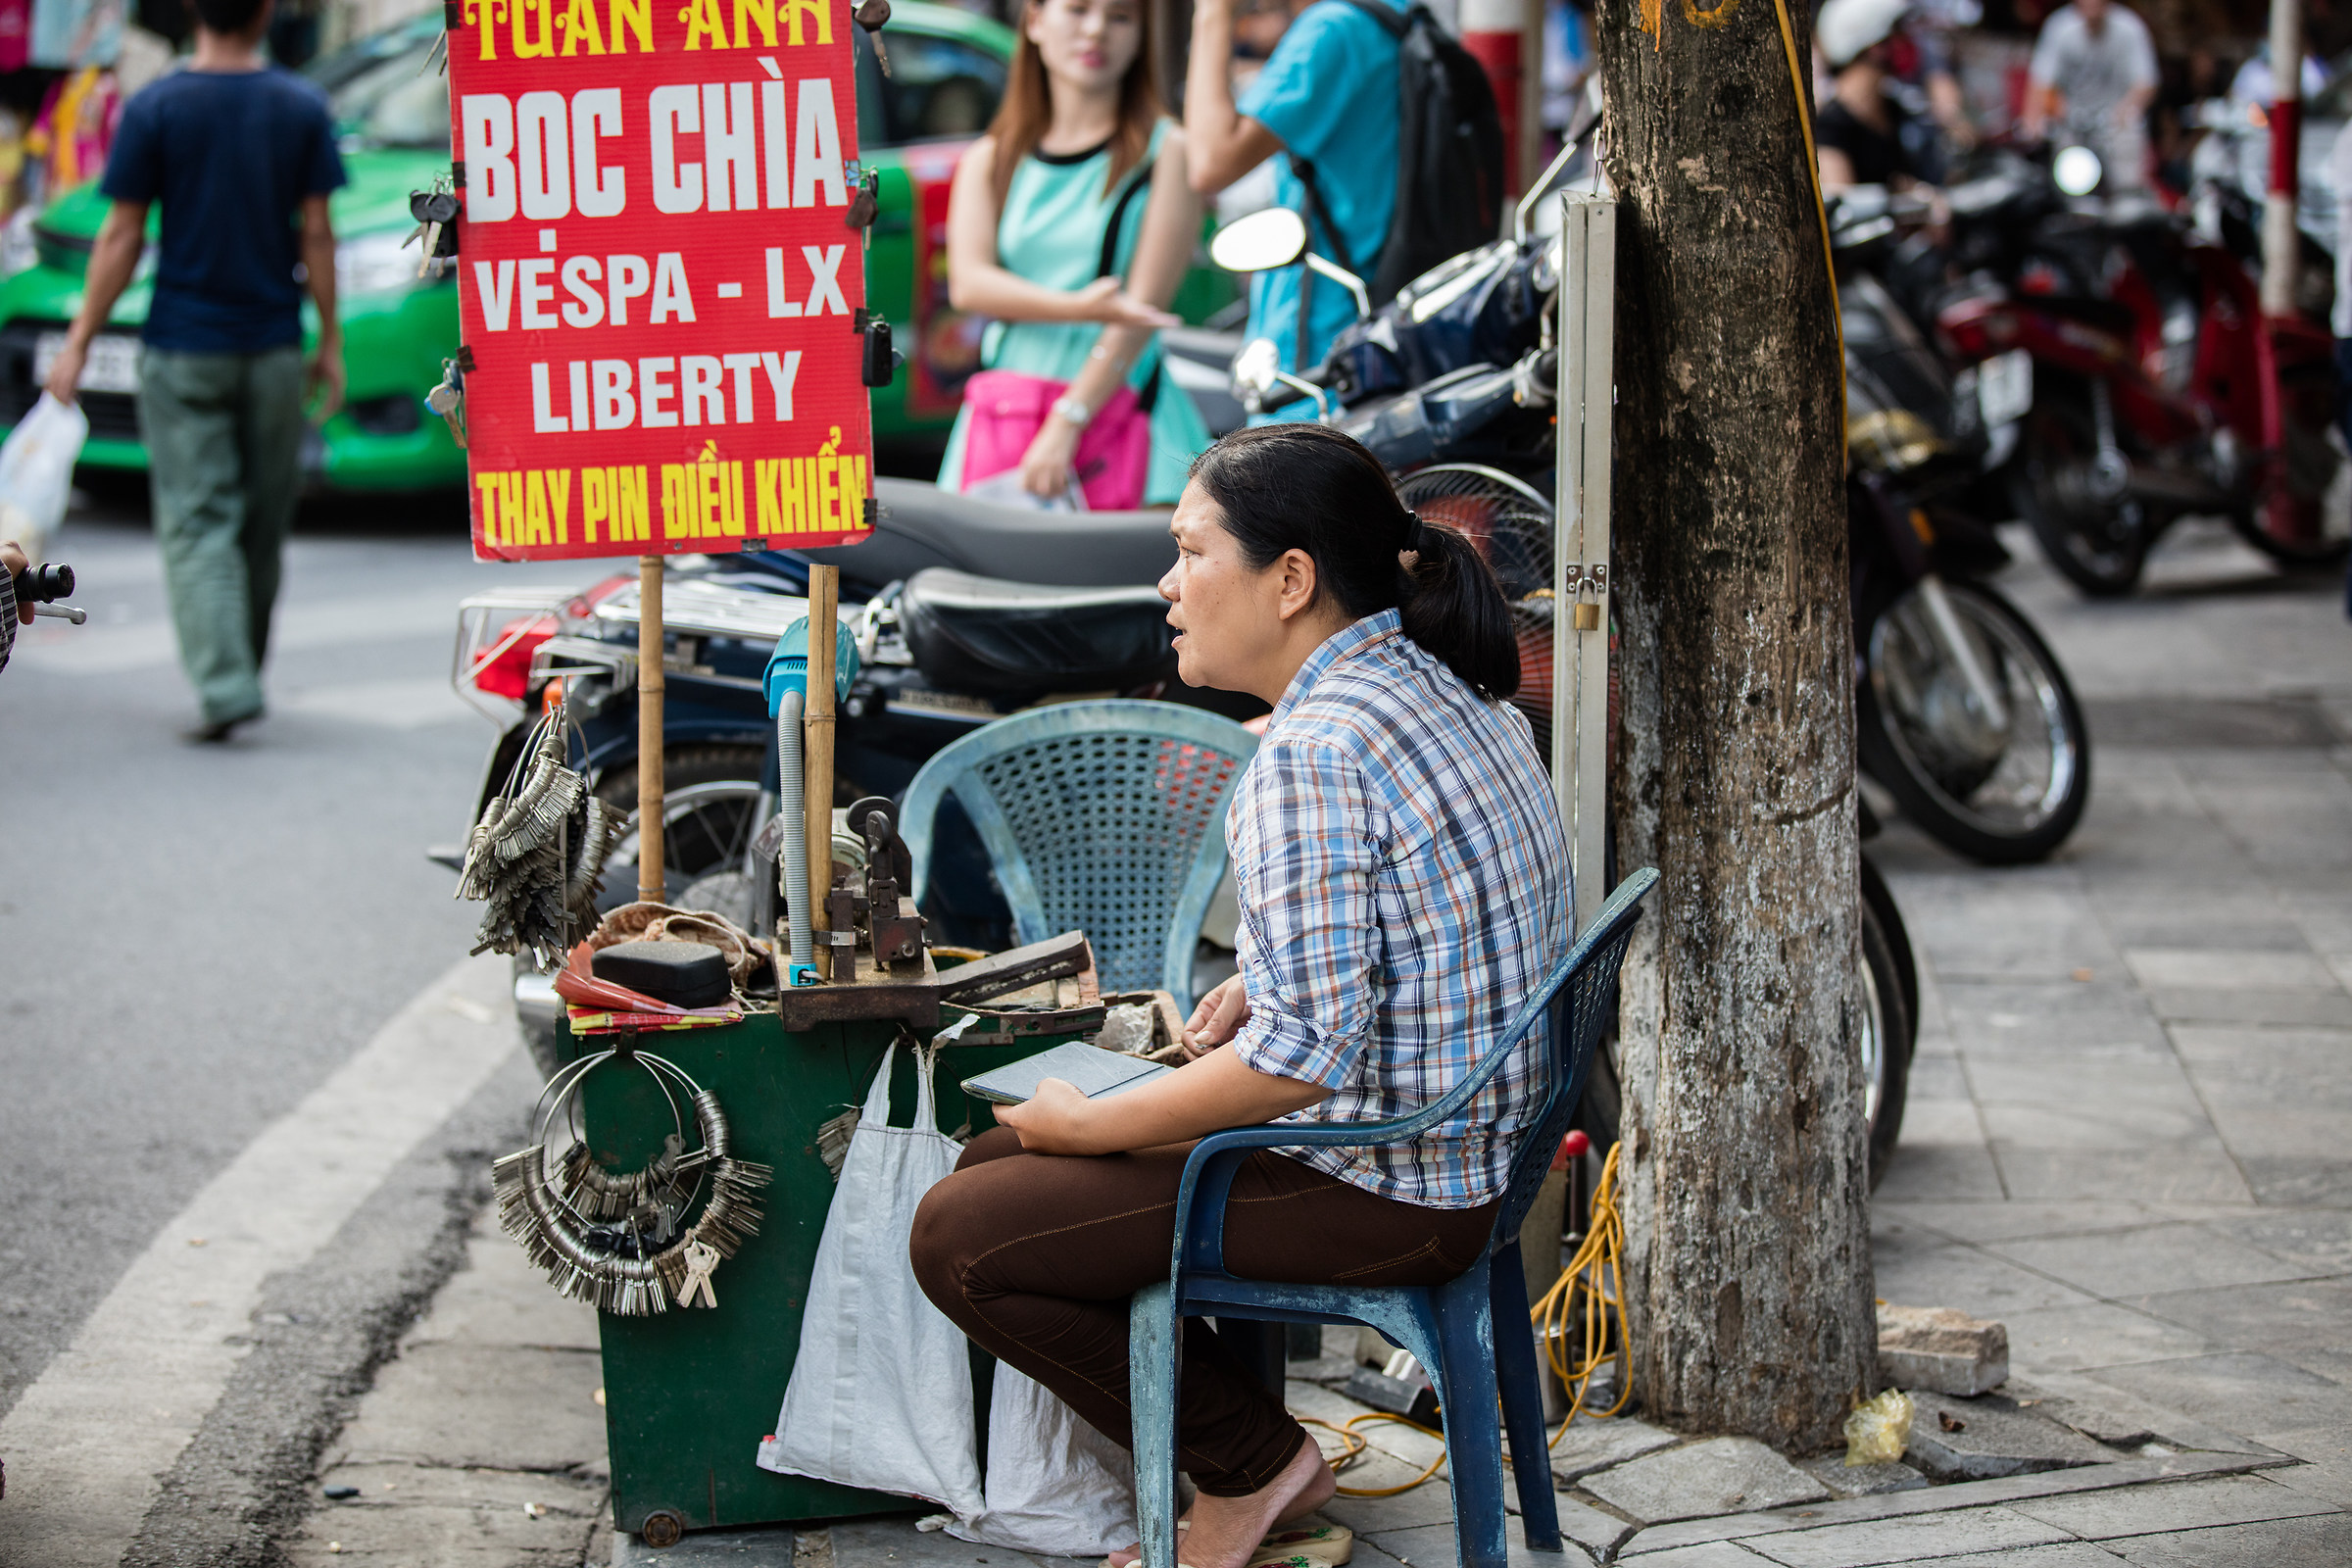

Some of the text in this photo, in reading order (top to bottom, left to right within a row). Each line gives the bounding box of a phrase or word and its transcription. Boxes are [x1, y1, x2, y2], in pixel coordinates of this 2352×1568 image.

[678, 0, 834, 51] ANH
[649, 57, 849, 214] CHÌA
[765, 244, 850, 318] LX
[531, 351, 802, 433] LIBERTY
[476, 426, 870, 549] THAY PIN ĐIỀU KHIỂN
